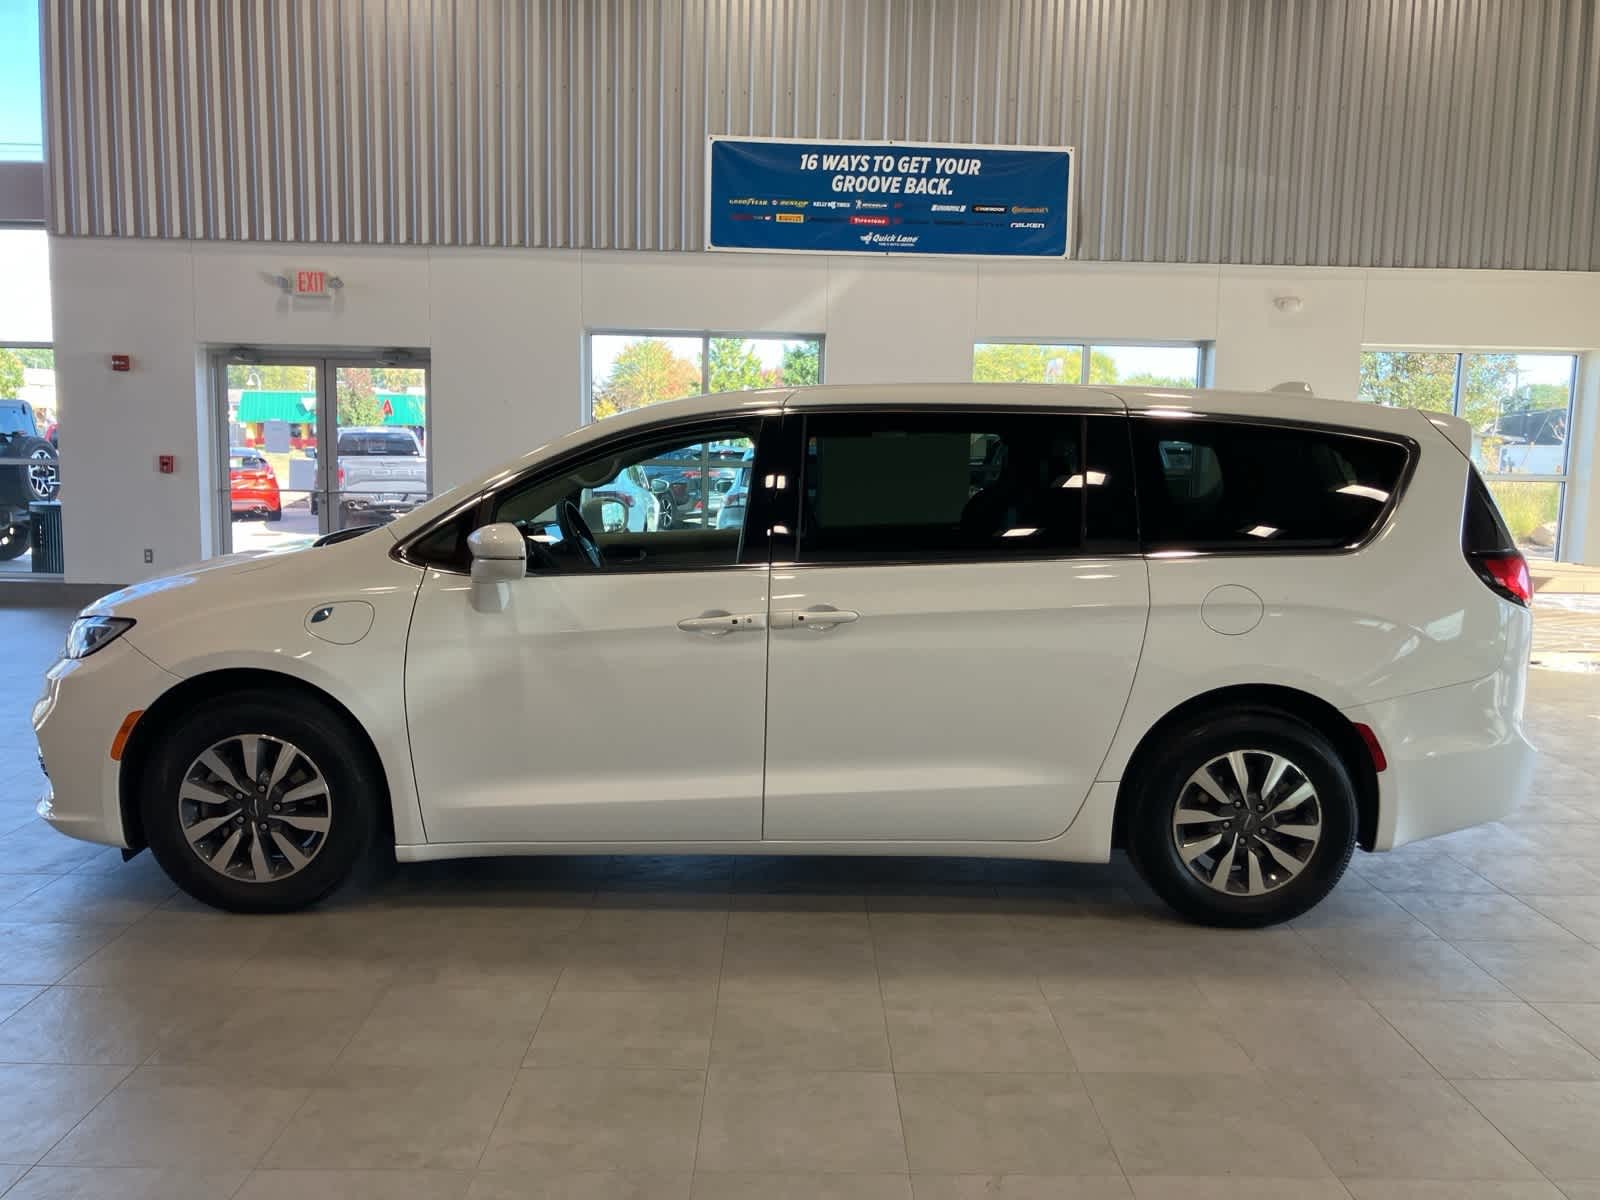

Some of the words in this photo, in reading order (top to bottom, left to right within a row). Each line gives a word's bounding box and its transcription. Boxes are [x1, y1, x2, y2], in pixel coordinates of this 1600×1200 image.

[800, 154, 818, 171] 16
[822, 155, 870, 173] WAYS
[873, 156, 895, 173] TO
[897, 157, 932, 175] GET
[935, 158, 981, 176] YOUR
[831, 175, 900, 194] GROOVE
[904, 177, 953, 196] BACK.
[872, 234, 897, 243] Quick
[896, 234, 919, 243] Lane
[298, 271, 325, 292] EXIT
